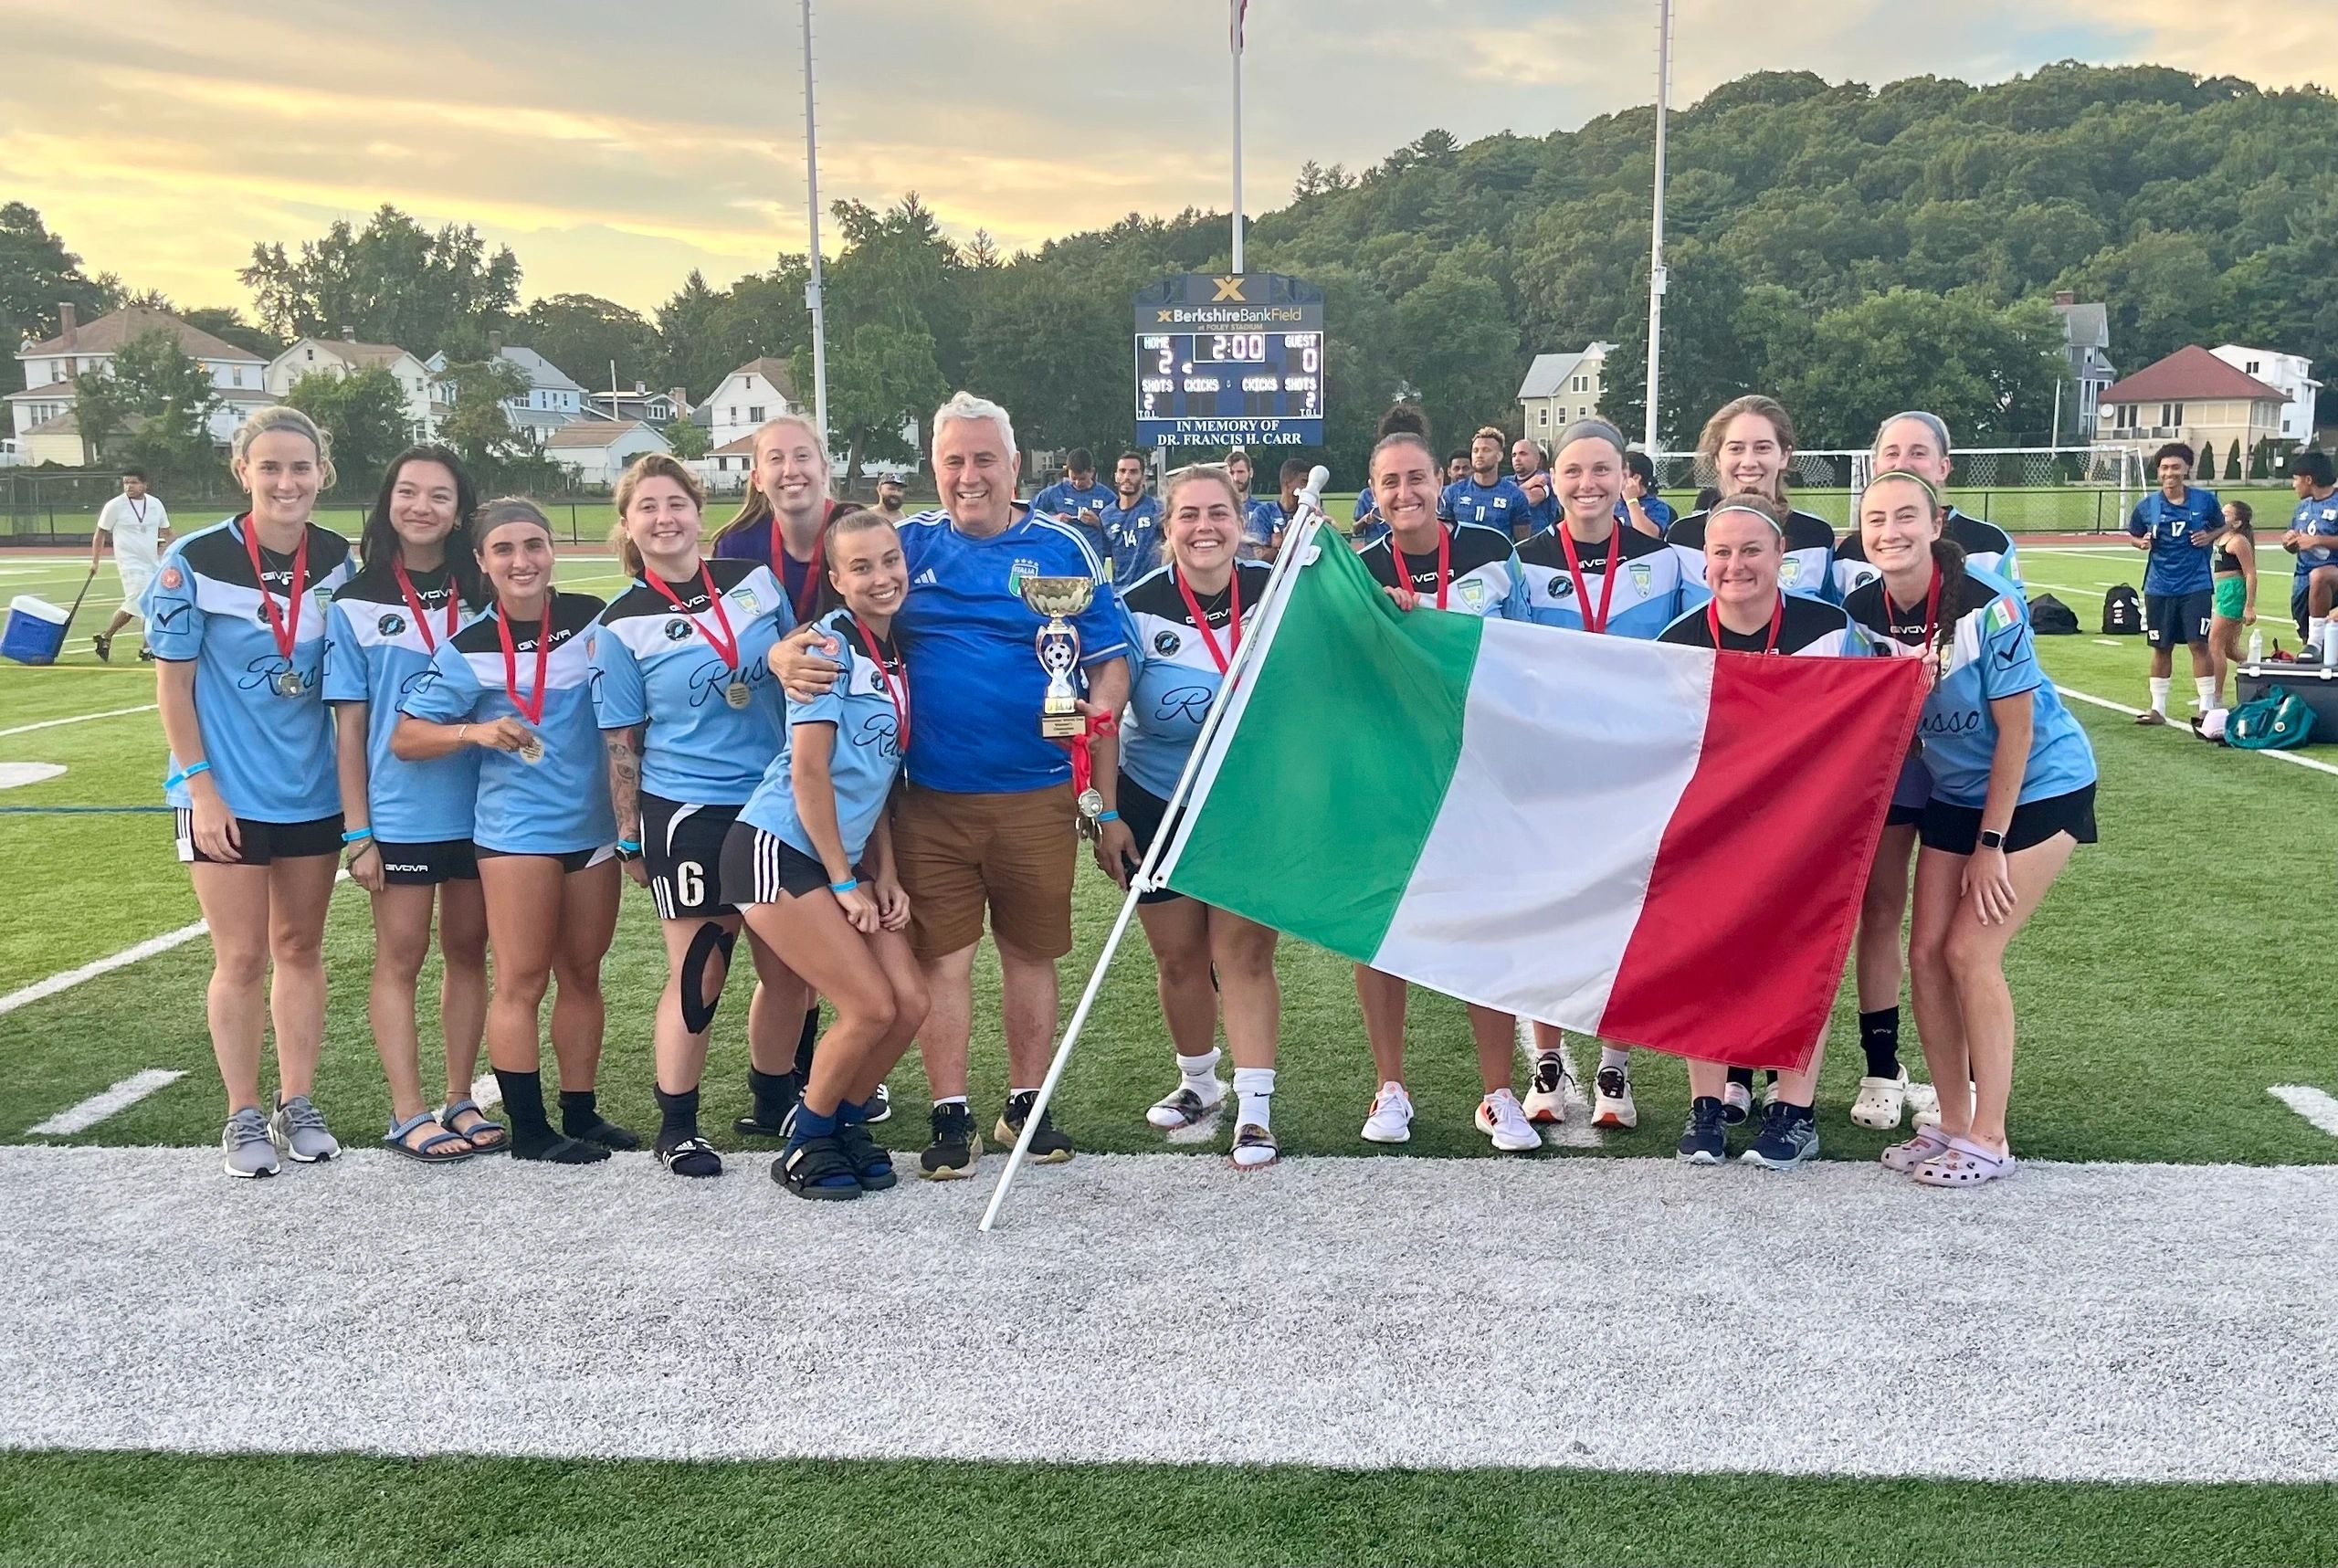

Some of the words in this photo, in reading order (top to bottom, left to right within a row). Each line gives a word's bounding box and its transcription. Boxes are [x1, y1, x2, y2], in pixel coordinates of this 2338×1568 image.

[1143, 336, 1169, 349] HOME
[1212, 335, 1262, 360] 2:00
[1284, 334, 1316, 348] GUEST
[1158, 350, 1173, 374] 2
[1302, 348, 1317, 373] 0
[1142, 378, 1174, 393] SHOTS
[1284, 377, 1317, 391] SHOTS
[1143, 394, 1154, 410] 2
[1305, 391, 1316, 408] 2
[1176, 421, 1193, 432] IN
[1195, 421, 1259, 432] MEMORY
[1260, 420, 1280, 431] OF
[1157, 435, 1180, 446] DR.
[1184, 434, 1243, 445] FRANCIS
[1246, 434, 1259, 445] H.
[1263, 433, 1302, 444] CARR
[1092, 499, 1103, 509] ES
[1493, 497, 1507, 509] ES
[1475, 506, 1485, 521] 11
[1137, 517, 1151, 529] ES
[2172, 521, 2186, 537] 17
[1122, 530, 1137, 547] 14
[384, 863, 428, 872] GIVOVA
[677, 861, 705, 907] 6
